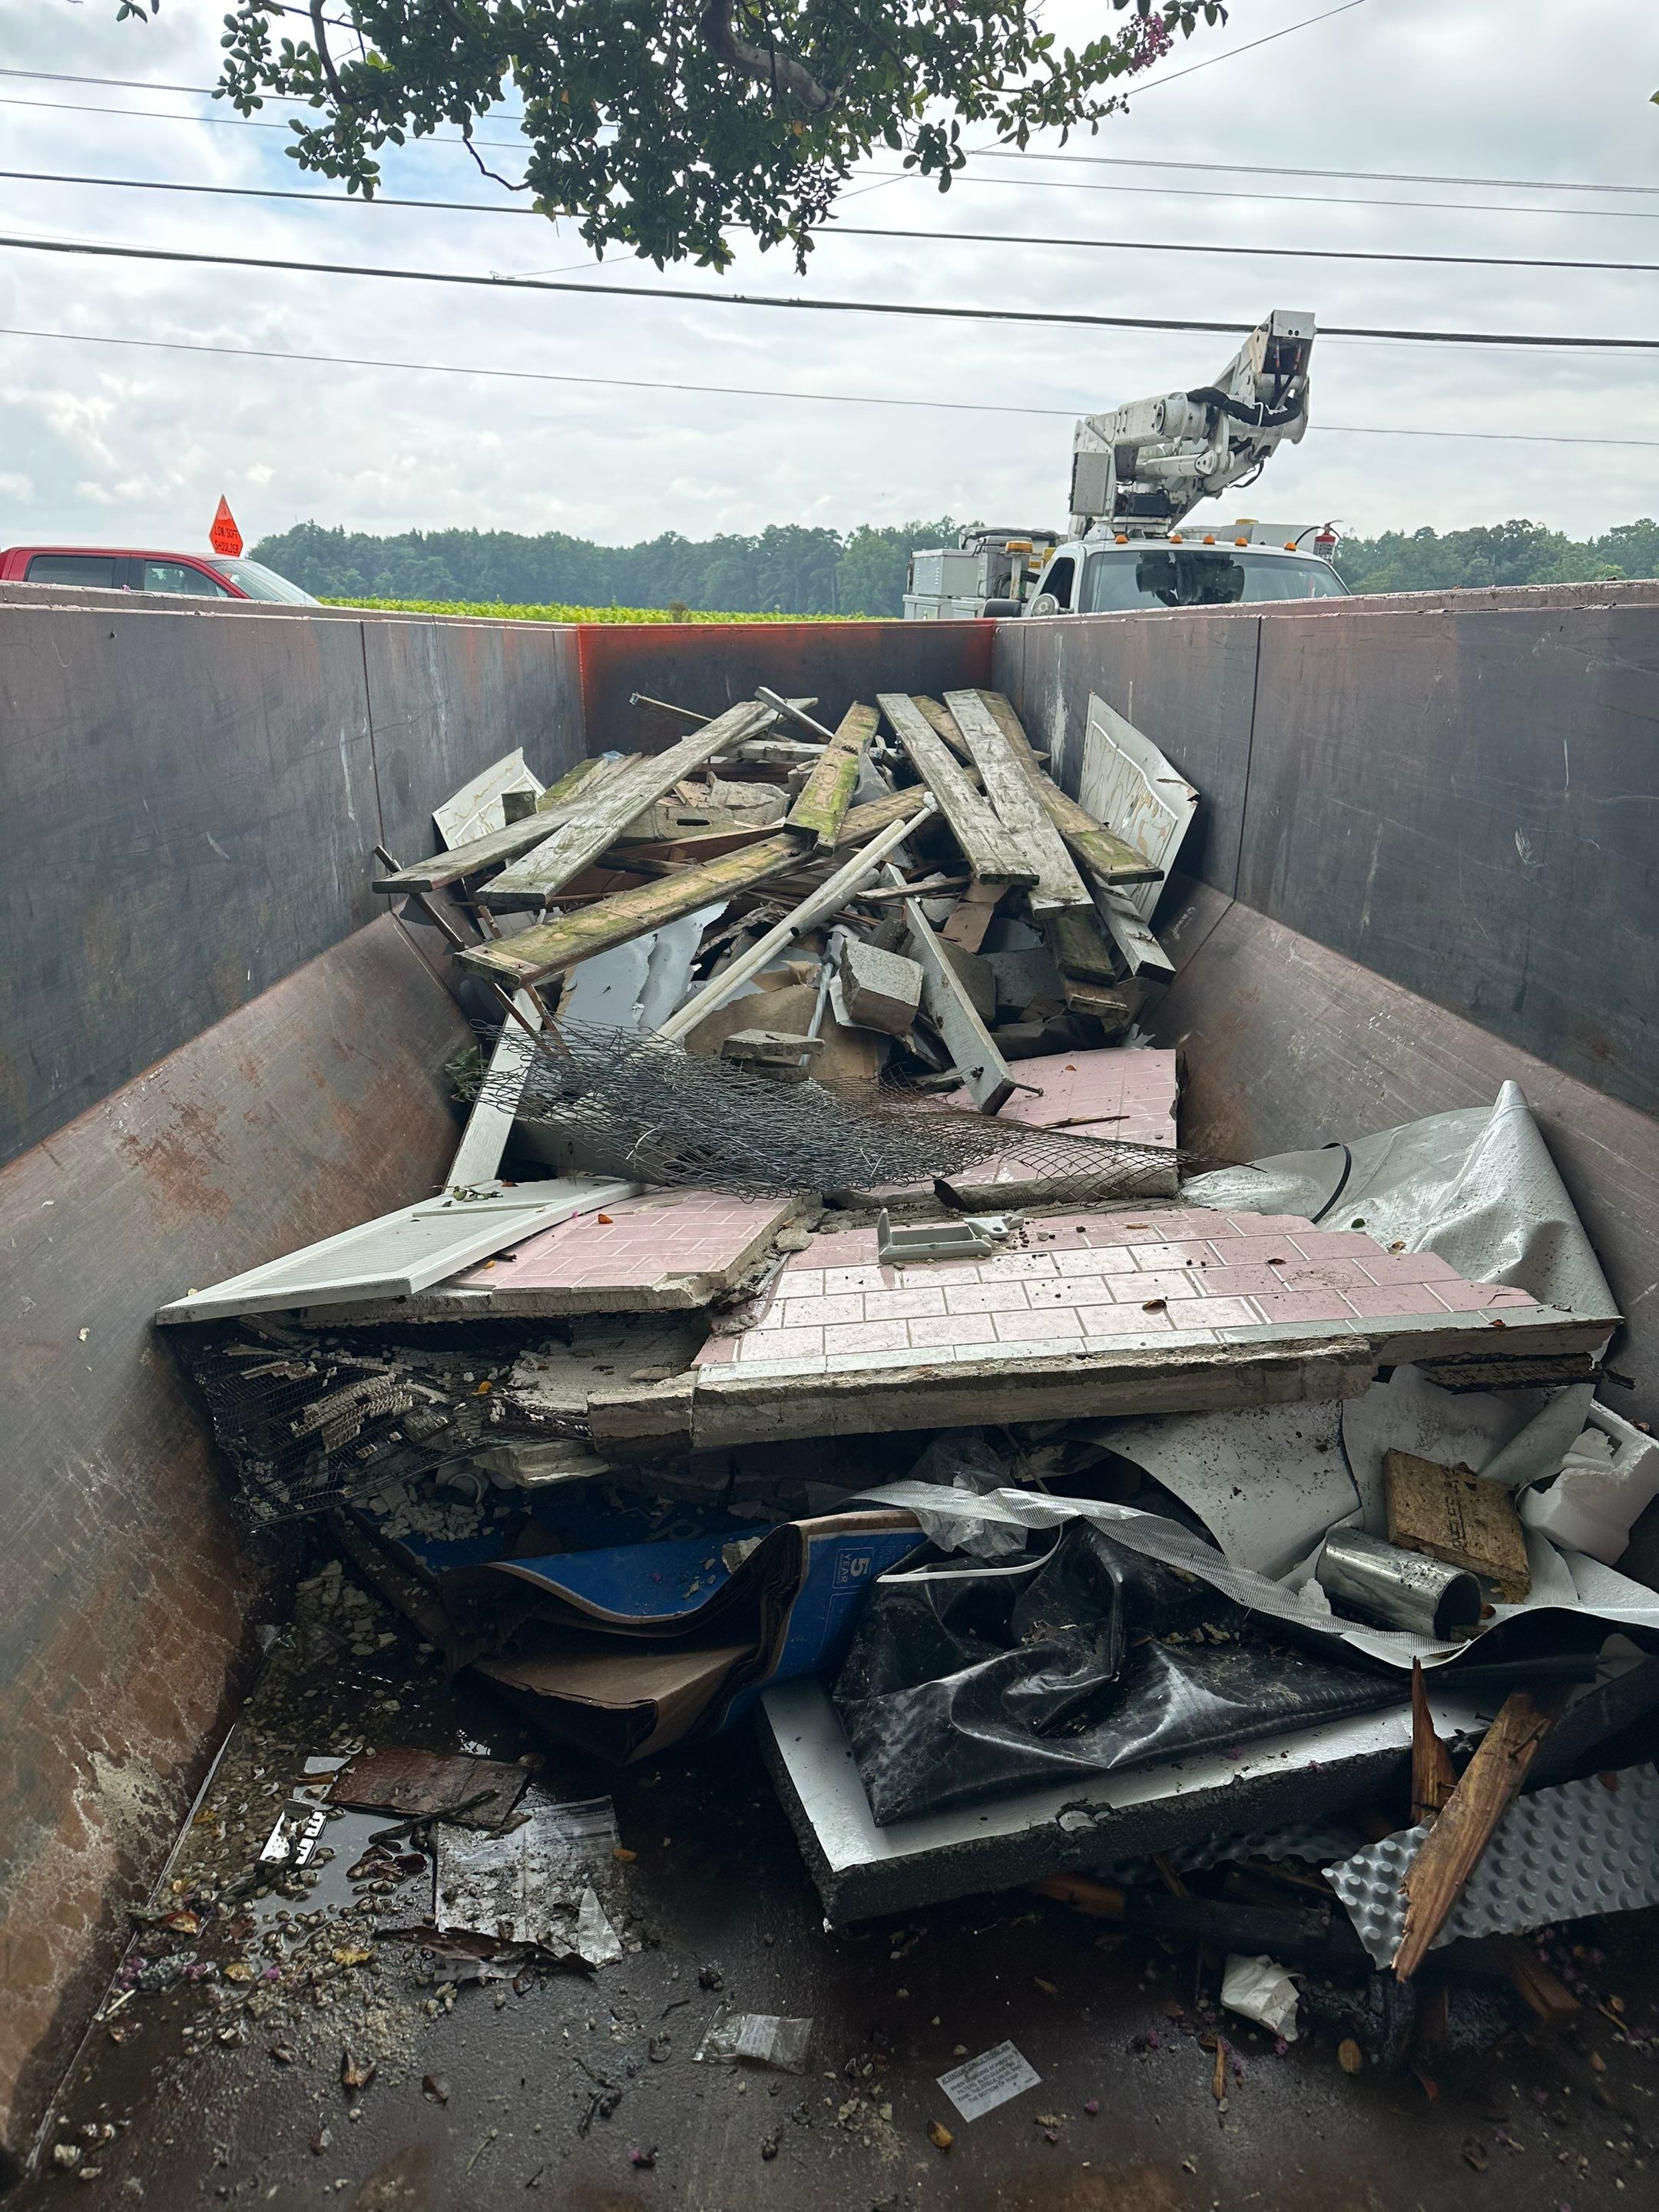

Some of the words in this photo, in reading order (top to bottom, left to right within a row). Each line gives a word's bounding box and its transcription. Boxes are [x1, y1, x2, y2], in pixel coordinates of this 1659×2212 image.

[214, 526, 237, 539] LOW/SOFT
[214, 539, 239, 554] SHOULDER
[841, 1553, 851, 1583] YEAR
[850, 1558, 870, 1577] 5
[968, 2094, 979, 2103] THE
[978, 2084, 998, 2098] BOTTOM
